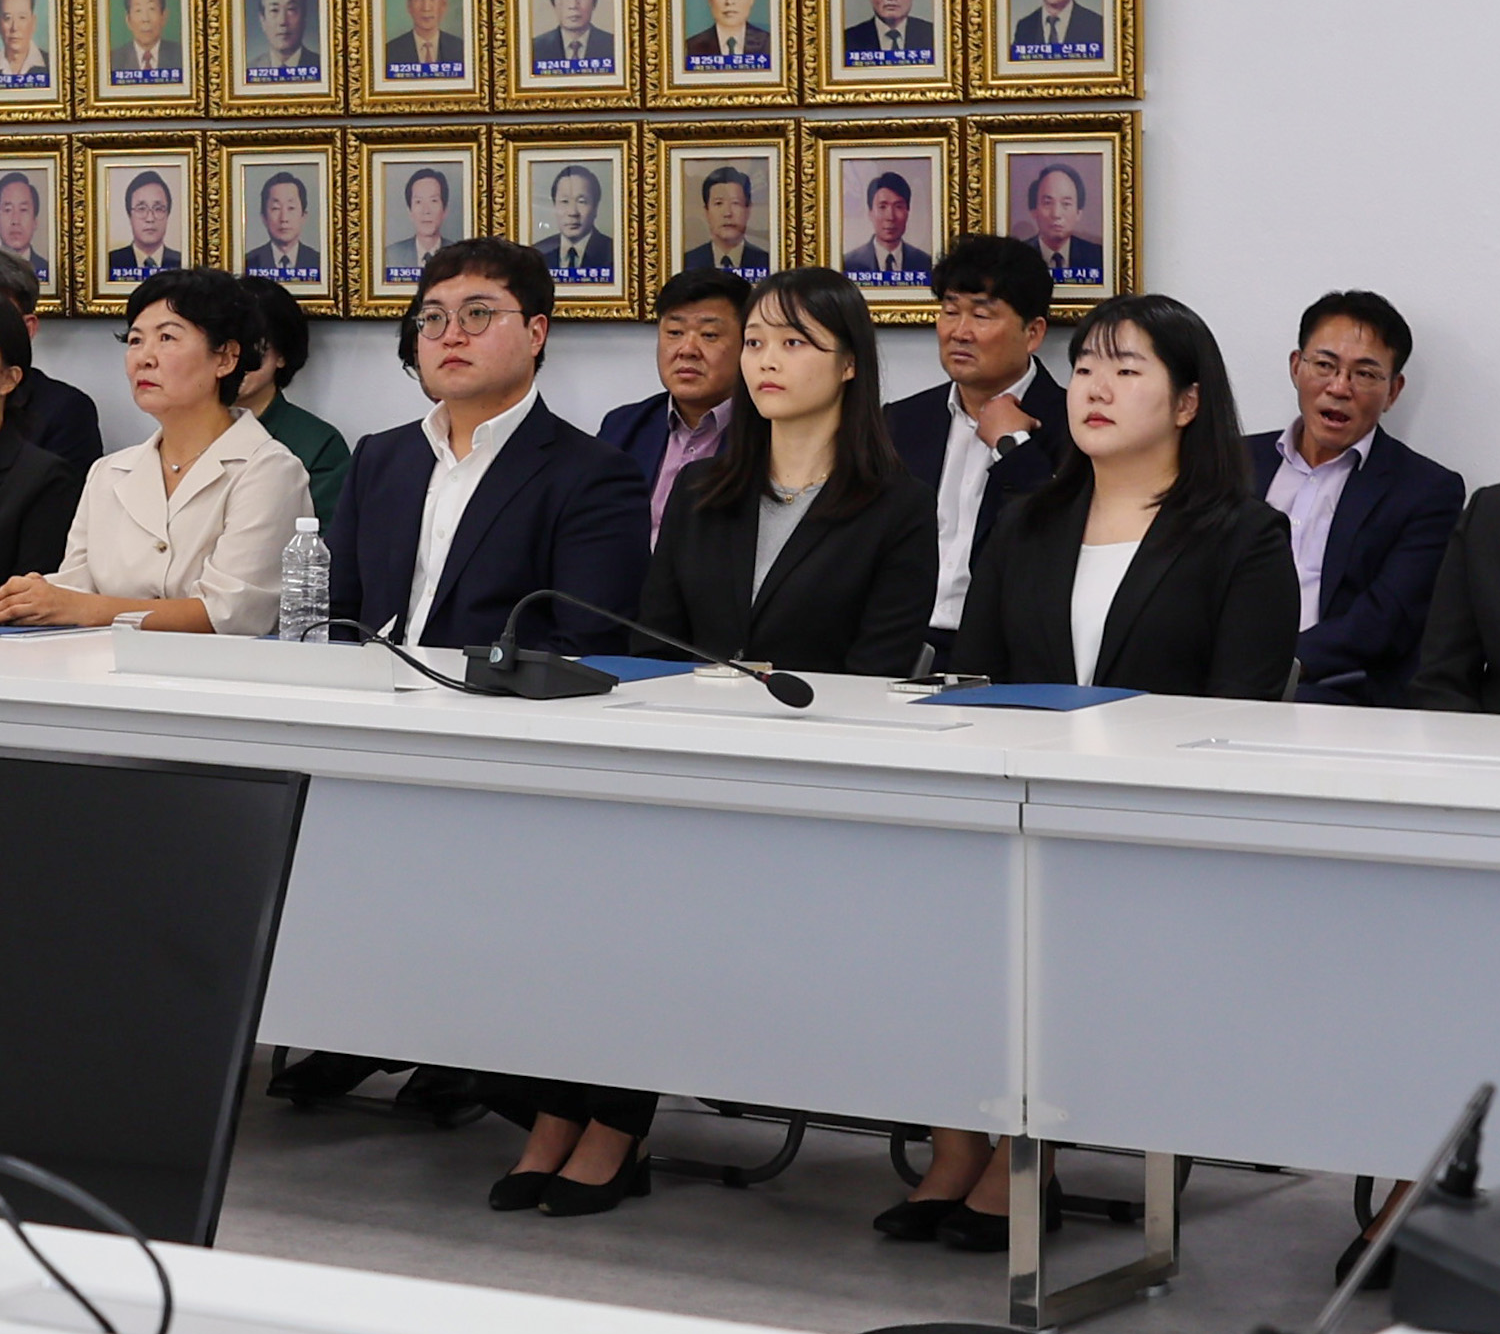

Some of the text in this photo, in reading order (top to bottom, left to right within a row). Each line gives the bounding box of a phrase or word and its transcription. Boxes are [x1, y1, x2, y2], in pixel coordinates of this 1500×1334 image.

[1015, 45, 1052, 54] 제27대
[690, 56, 724, 64] 제25대
[849, 52, 885, 61] 제26대
[390, 64, 422, 73] 제23대
[537, 60, 571, 69] 제24대
[115, 71, 143, 79] 제21대
[249, 68, 279, 77] 제22대
[112, 268, 142, 277] 제34대
[249, 268, 279, 277] 제35대
[389, 268, 421, 277] 제36대
[848, 272, 882, 280] 제39대
